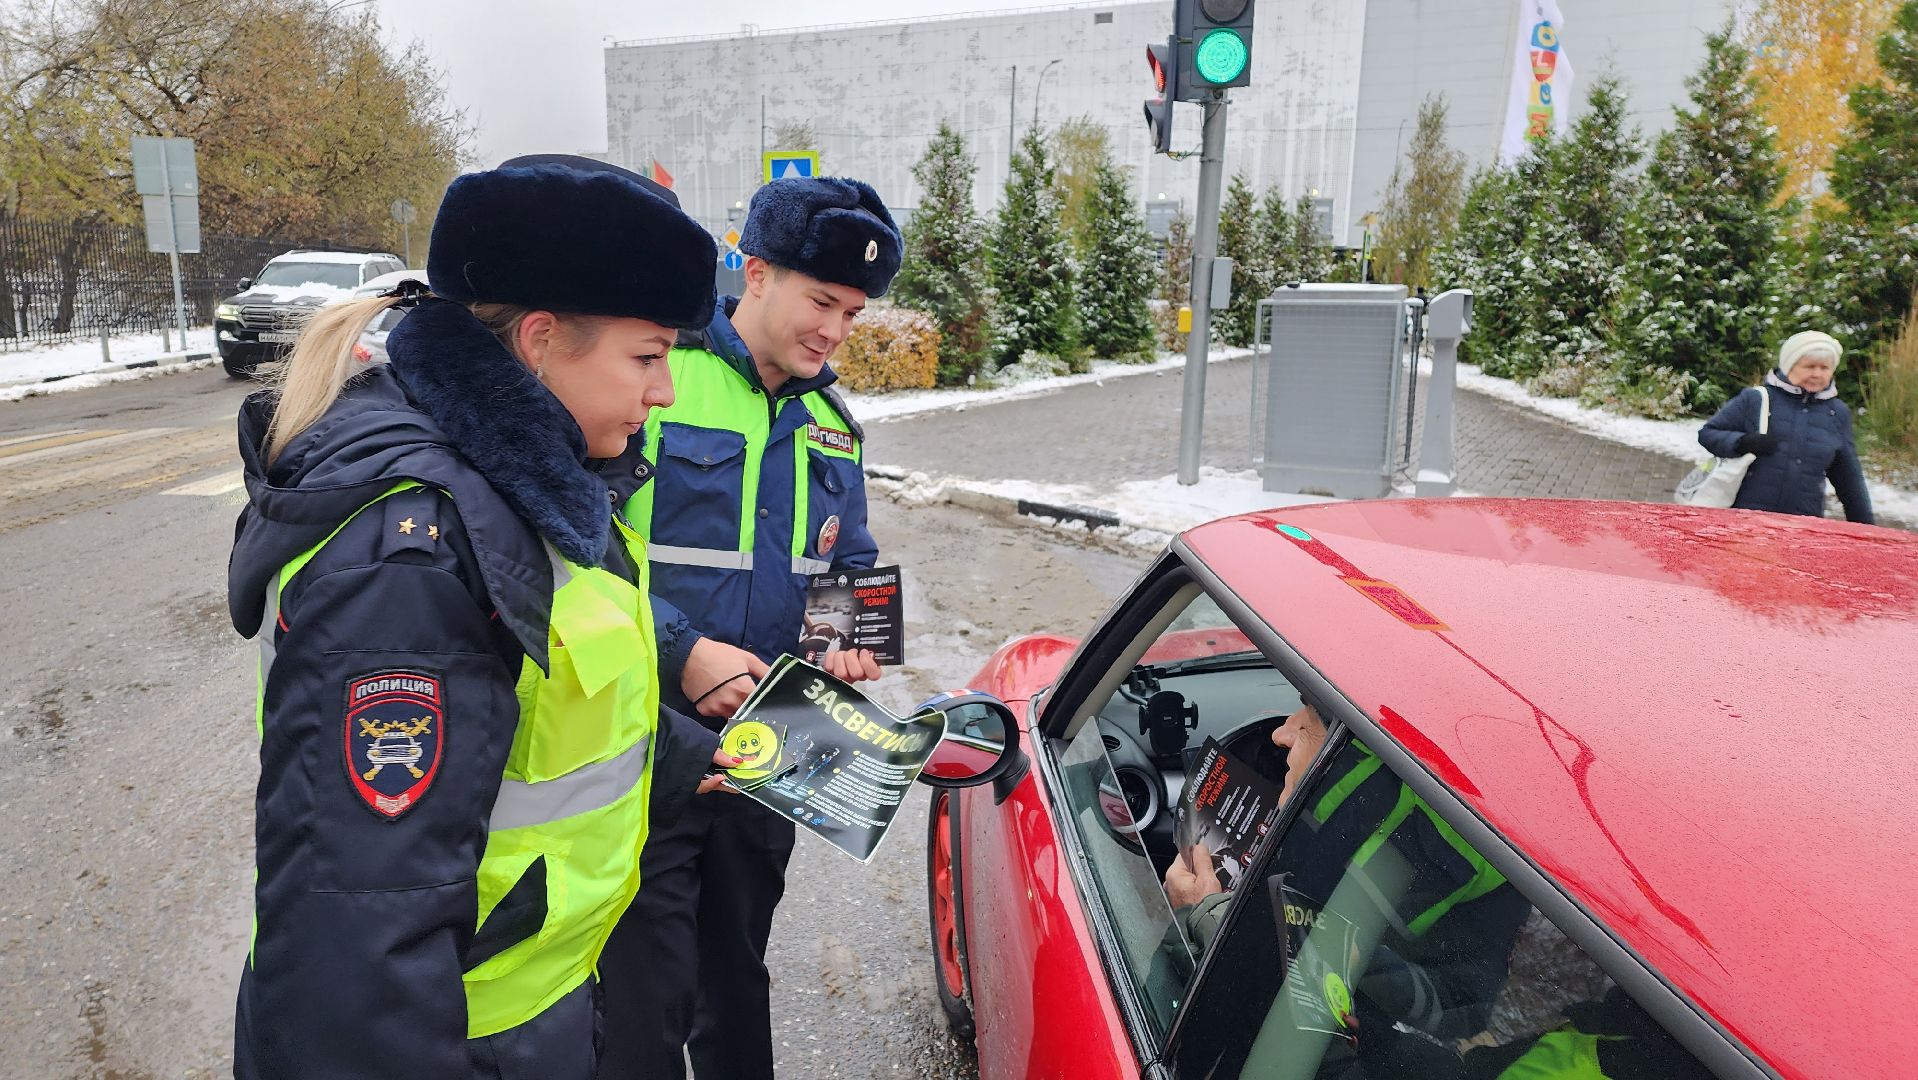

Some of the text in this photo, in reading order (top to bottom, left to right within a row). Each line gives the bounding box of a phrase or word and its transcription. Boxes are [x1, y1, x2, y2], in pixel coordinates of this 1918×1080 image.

[820, 430, 851, 449] ГИБДД
[854, 574, 897, 587] СОБЛЮДАЙТЕ
[853, 586, 897, 598] СКОРОСТНОЙ
[863, 597, 889, 607] РЕЖИМ!
[355, 678, 434, 699] ПОЛИЦИЯ
[1187, 747, 1219, 803] СОБЛЮДАЙТЕ
[1194, 755, 1228, 812] СКОРОСТНОЙ
[1206, 771, 1230, 807] РЕЖИМ!
